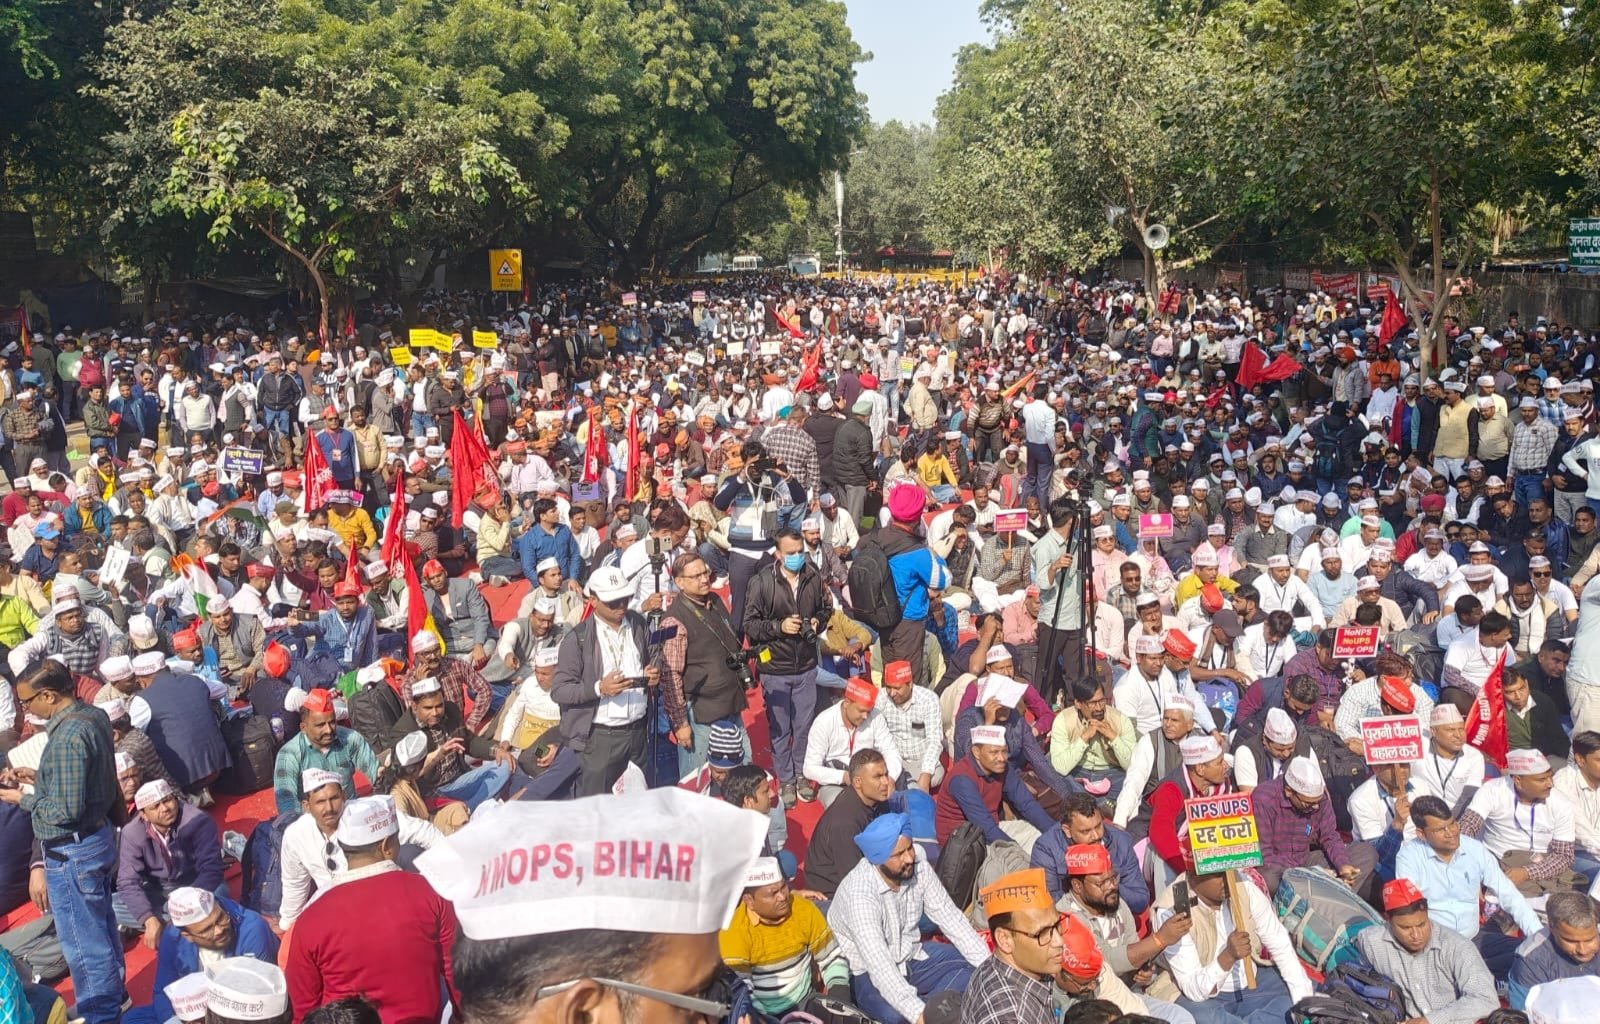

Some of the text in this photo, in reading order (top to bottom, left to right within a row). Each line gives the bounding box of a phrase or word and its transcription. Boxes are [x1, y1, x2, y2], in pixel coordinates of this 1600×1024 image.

[1569, 235, 1591, 247] जनता
[1336, 645, 1374, 655] Only OPS
[1343, 637, 1370, 645] NoUPS
[1364, 722, 1392, 745] पुरानी
[1472, 723, 1490, 746] UNION
[1369, 741, 1418, 760] बहाल करो
[1189, 799, 1249, 818] NPS/UPS
[1194, 817, 1252, 844] रद्द करो
[593, 840, 696, 882] BIHAR
[996, 885, 1039, 903] रामपुर
[249, 1000, 264, 1014] करो
